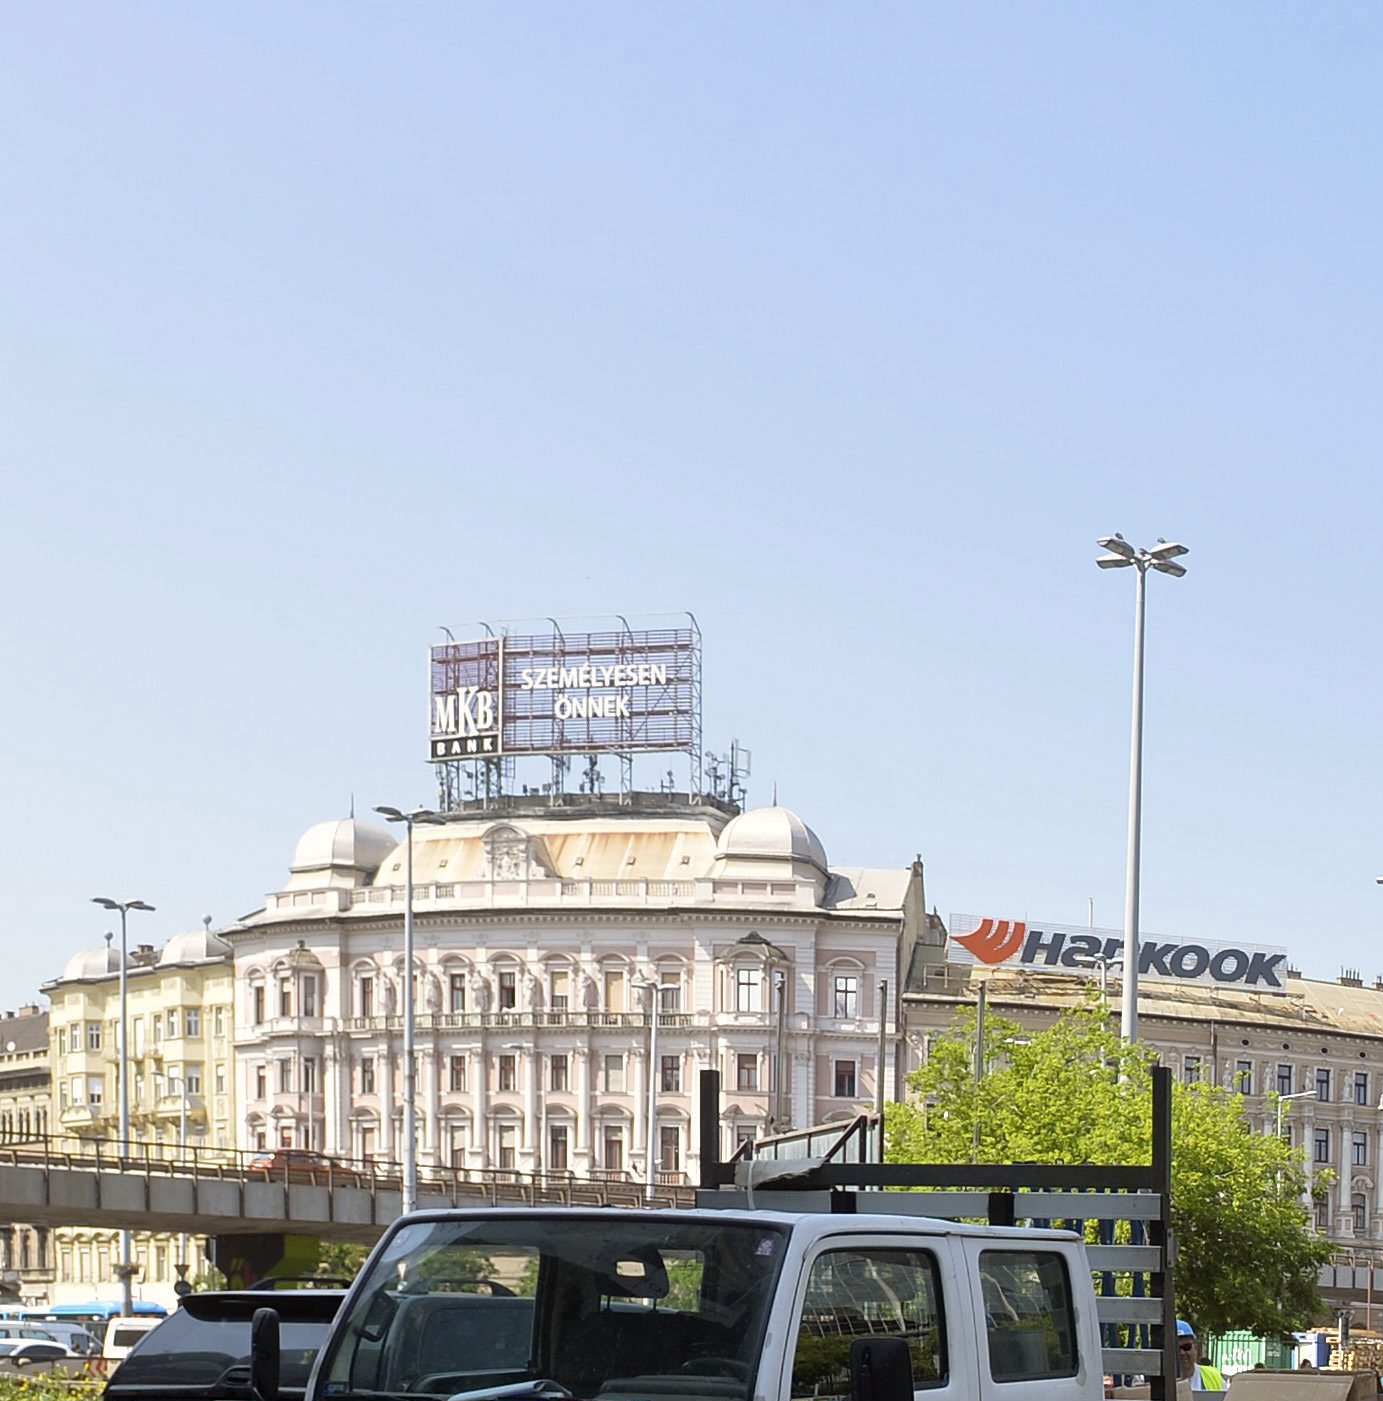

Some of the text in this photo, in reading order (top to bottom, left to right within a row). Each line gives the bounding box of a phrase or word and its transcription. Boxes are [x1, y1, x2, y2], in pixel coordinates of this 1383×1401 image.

[521, 663, 667, 690] SZEMÉLYESEN
[434, 685, 493, 737] MKB
[554, 694, 630, 720] ÖNNEK
[436, 738, 493, 756] BANK
